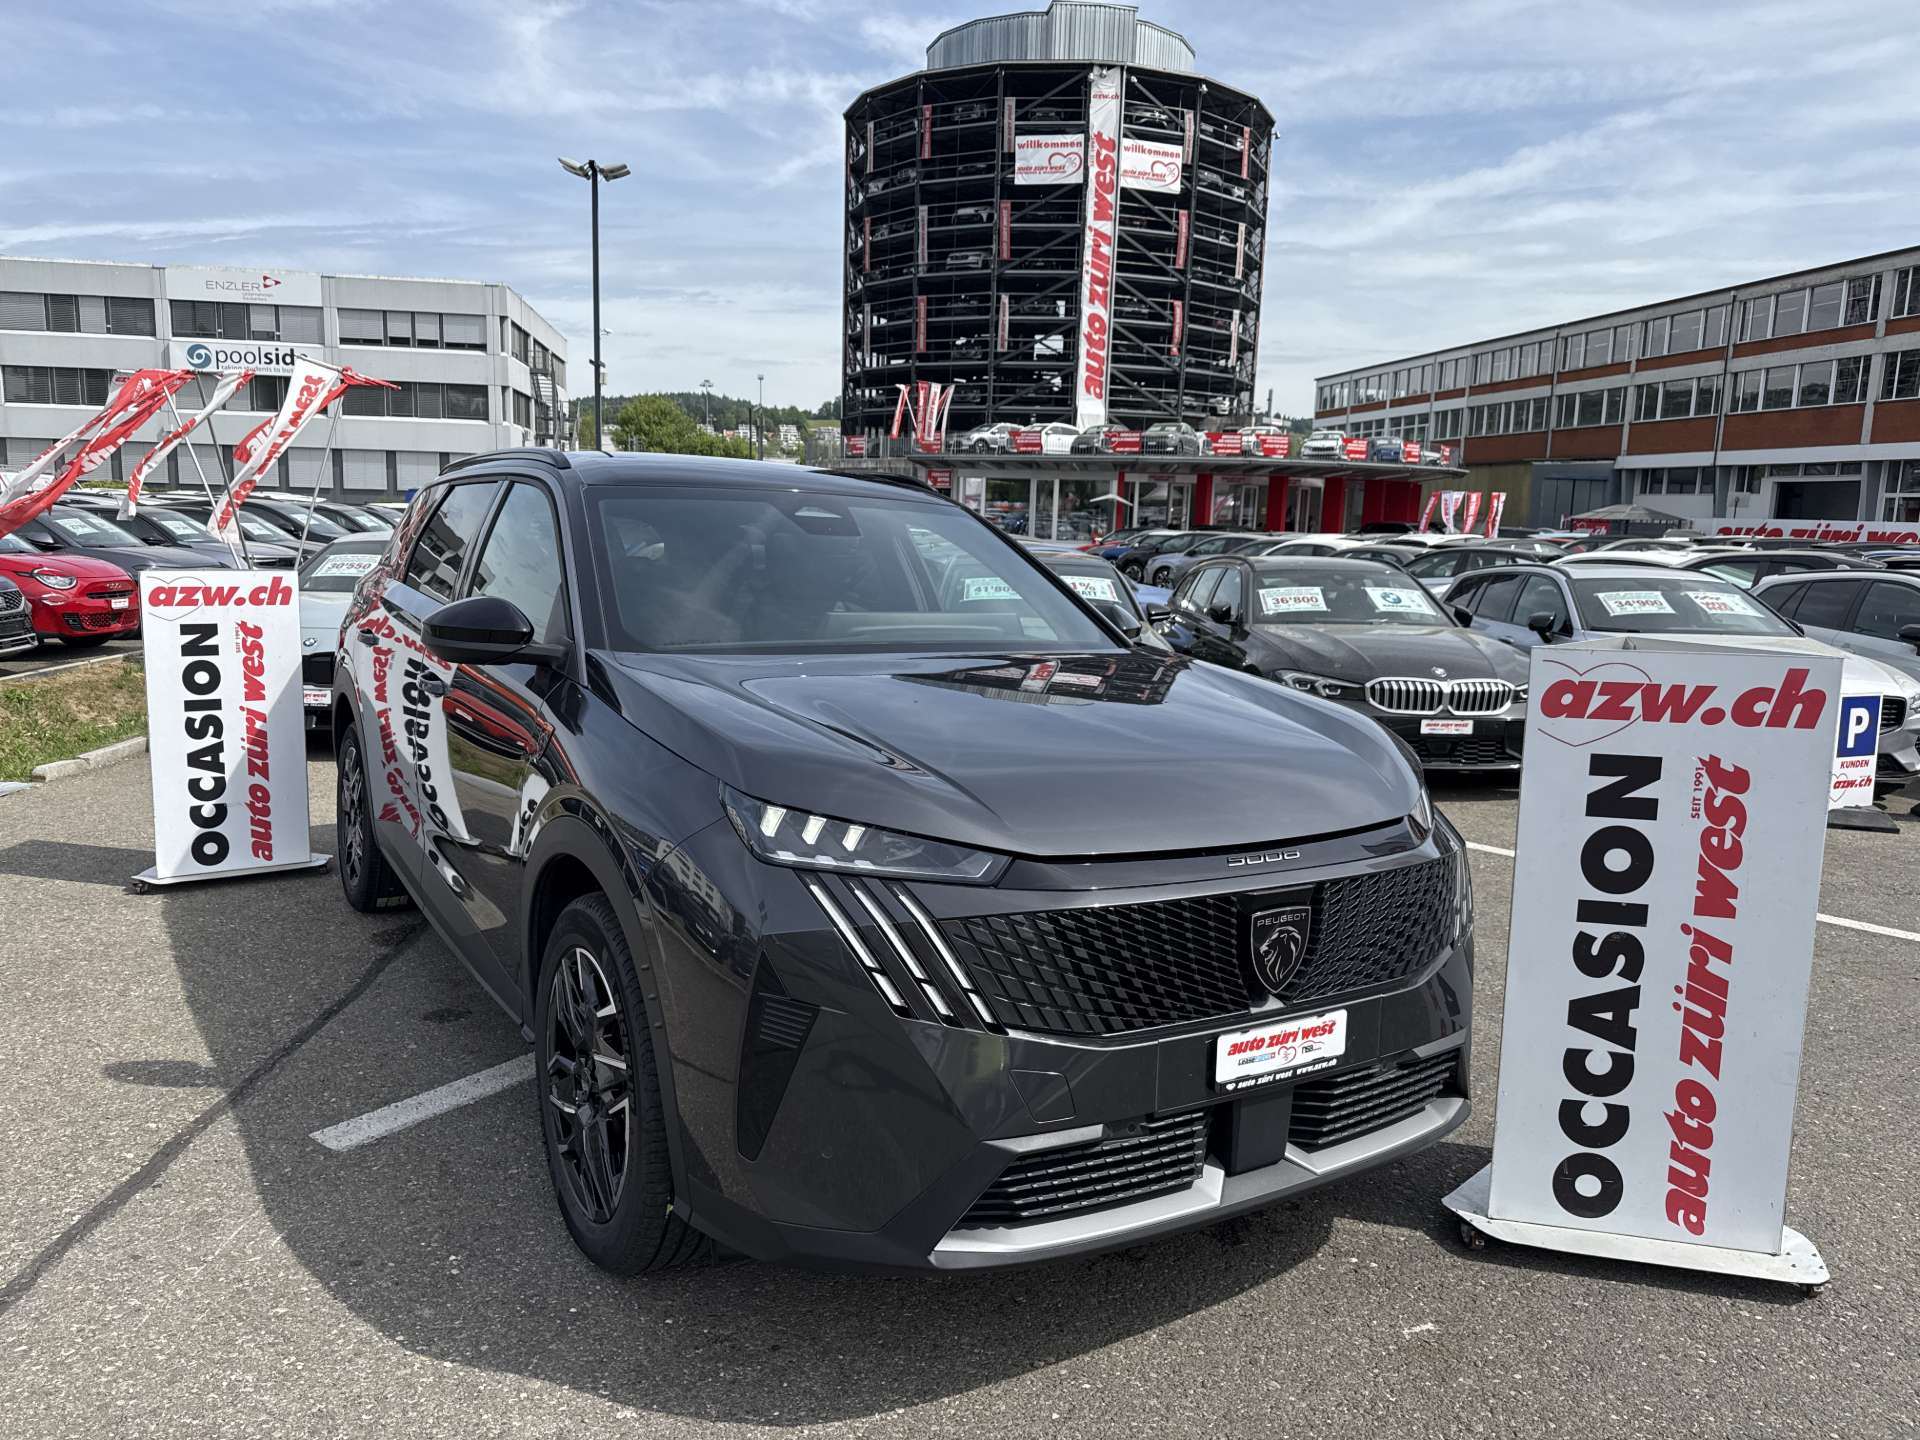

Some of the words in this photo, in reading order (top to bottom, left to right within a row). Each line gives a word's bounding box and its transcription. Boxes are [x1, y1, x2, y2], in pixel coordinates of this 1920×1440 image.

[1017, 140, 1082, 149] willkommen
[1123, 144, 1180, 158] willkommen
[1093, 131, 1117, 222] west
[206, 280, 260, 291] ENZLER
[1086, 225, 1113, 311] züri
[1084, 312, 1107, 400] auto
[327, 562, 371, 570] 30'550
[148, 577, 293, 607] azw.ch
[1271, 597, 1319, 605] 36'800
[1614, 599, 1664, 608] 34'900
[237, 620, 266, 702] west
[1540, 668, 1828, 730] azw.ch
[180, 622, 230, 867] OCCASION
[238, 705, 270, 782] züri
[1846, 707, 1870, 748] P
[1693, 767, 1705, 792] 1991
[1840, 759, 1870, 769] KUNDEN
[1833, 776, 1872, 790] azw.ch
[244, 783, 273, 862] auto
[1690, 796, 1700, 820] SEIT
[1693, 753, 1752, 920] west
[1257, 912, 1306, 927] PEUGEOT
[1552, 752, 1664, 1219] OCCASION
[1671, 923, 1734, 1082] züri
[1227, 1035, 1266, 1057] auto
[1266, 1026, 1301, 1049] züri
[1302, 1020, 1337, 1040] west
[1237, 1078, 1256, 1089] auto
[1275, 1069, 1293, 1080] west
[1663, 1078, 1718, 1237] auto
